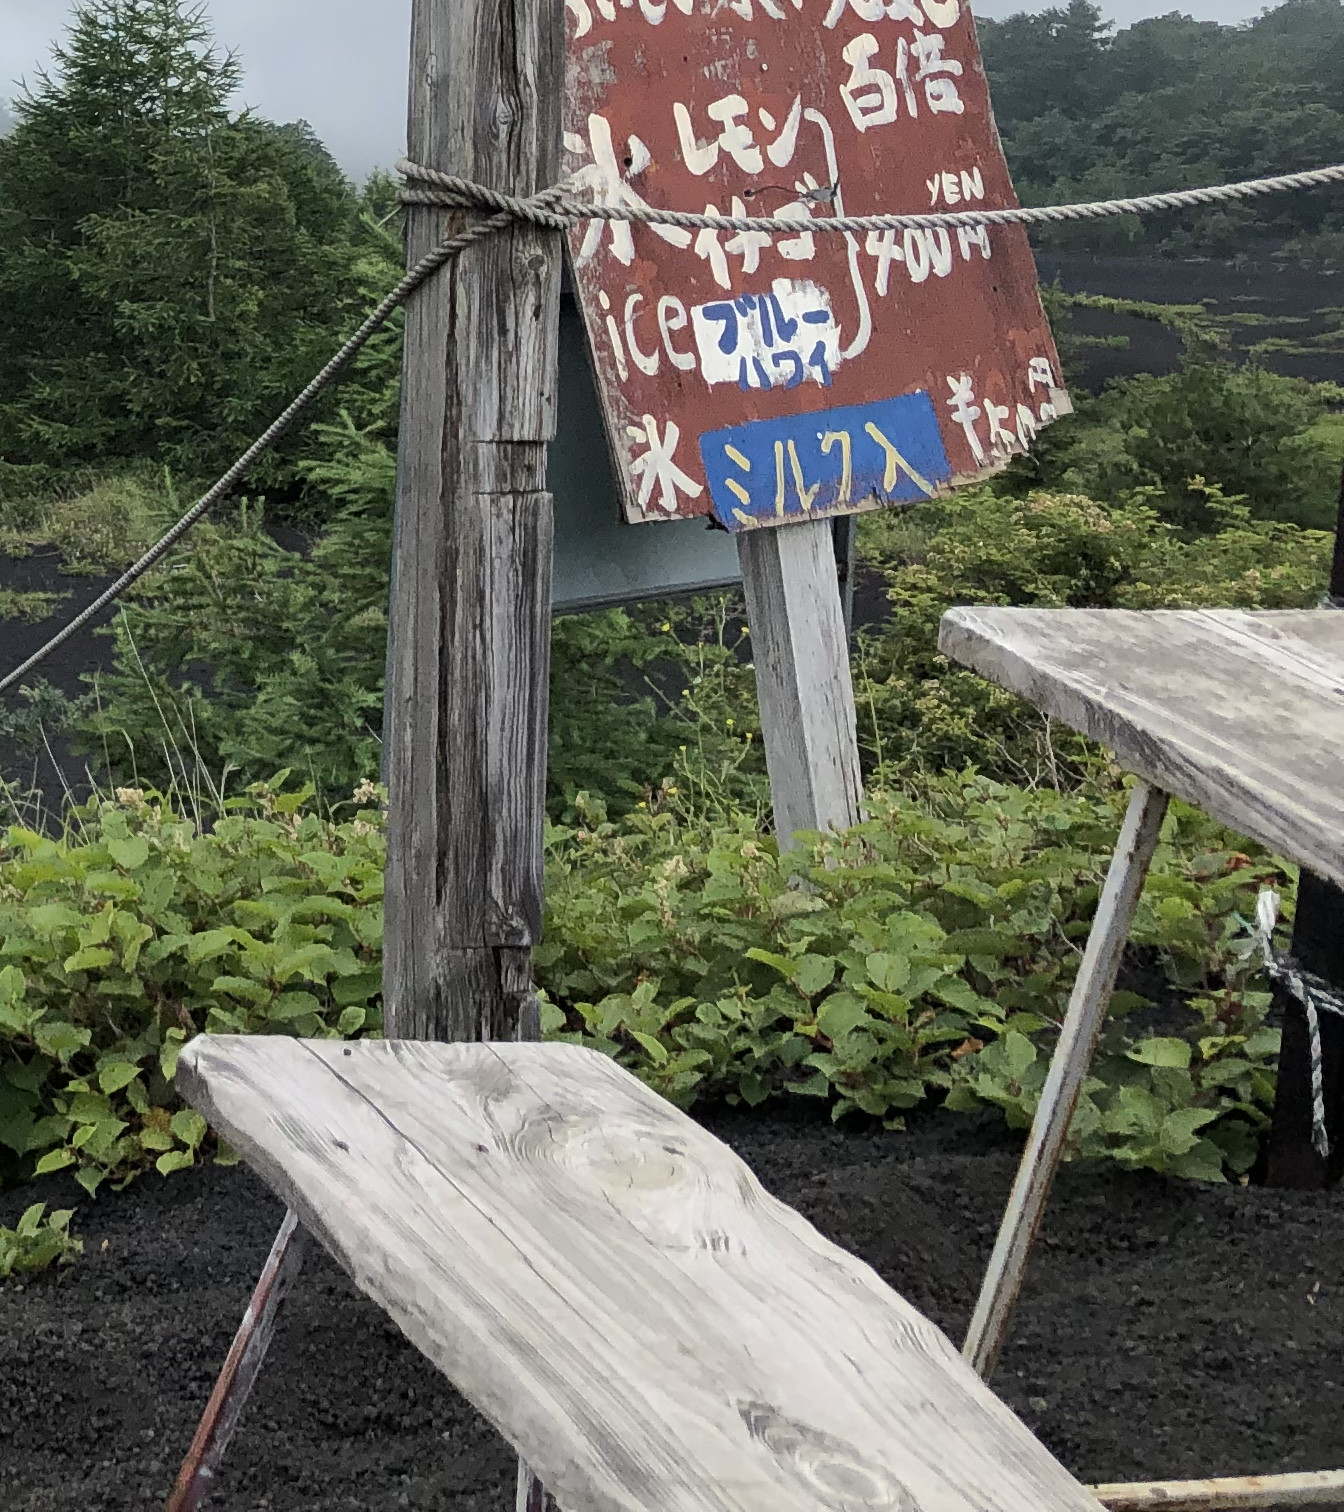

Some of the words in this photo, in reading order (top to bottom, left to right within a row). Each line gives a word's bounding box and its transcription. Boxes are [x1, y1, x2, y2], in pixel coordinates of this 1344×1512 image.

[840, 28, 964, 133] 百倍
[673, 93, 802, 176] レモン
[925, 165, 985, 206] YEN
[695, 171, 817, 290] イチゴ
[598, 289, 697, 382] ice
[702, 292, 830, 355] ブルー
[738, 340, 832, 392] ハワイ
[626, 414, 704, 512] 氷
[724, 421, 938, 526] ミルク入
